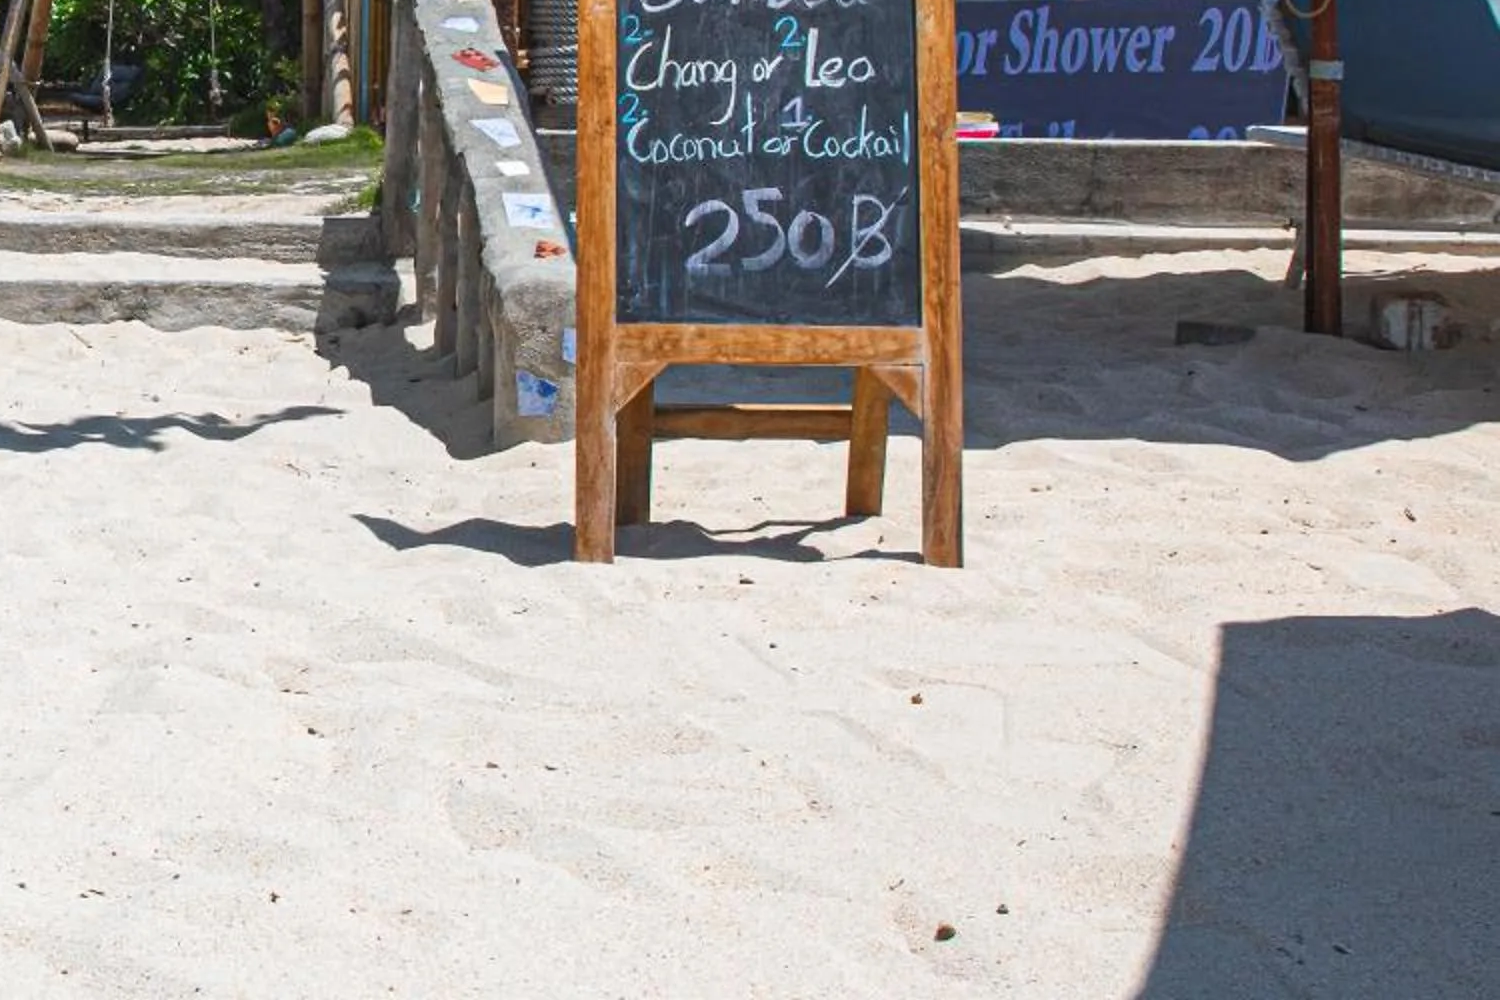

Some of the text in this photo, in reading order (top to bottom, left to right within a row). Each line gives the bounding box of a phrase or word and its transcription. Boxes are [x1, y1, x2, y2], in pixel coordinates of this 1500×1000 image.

[626, 24, 737, 125] Chang
[753, 54, 785, 83] or
[805, 27, 877, 87] Leo
[1003, 5, 1176, 75] Shower
[627, 91, 757, 164] Coconut
[763, 134, 799, 155] or
